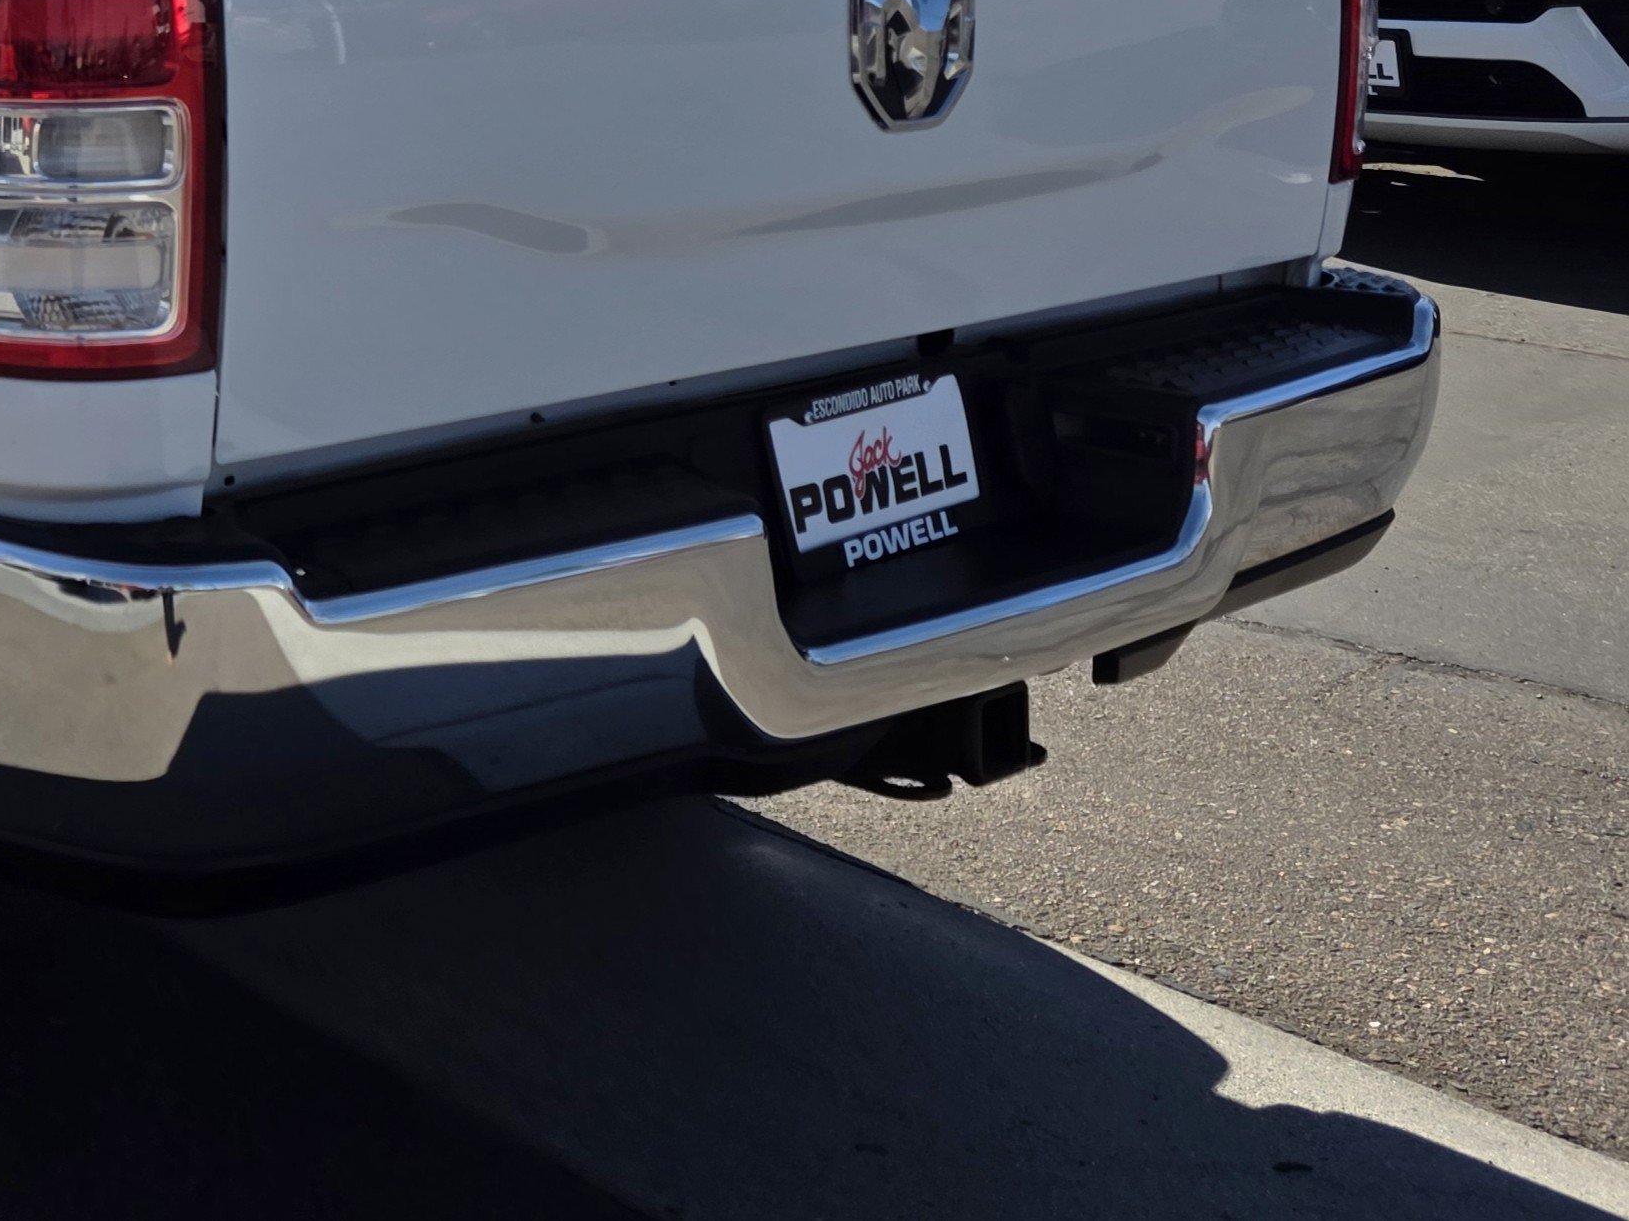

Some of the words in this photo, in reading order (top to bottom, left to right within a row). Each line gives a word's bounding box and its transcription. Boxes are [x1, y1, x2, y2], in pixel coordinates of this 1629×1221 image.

[812, 385, 870, 420] ESCONDIDO
[870, 379, 897, 405] AUTO
[895, 374, 921, 399] PARK
[789, 444, 968, 535] POWELL
[849, 426, 902, 500] Jack
[843, 511, 959, 568] POWELL
